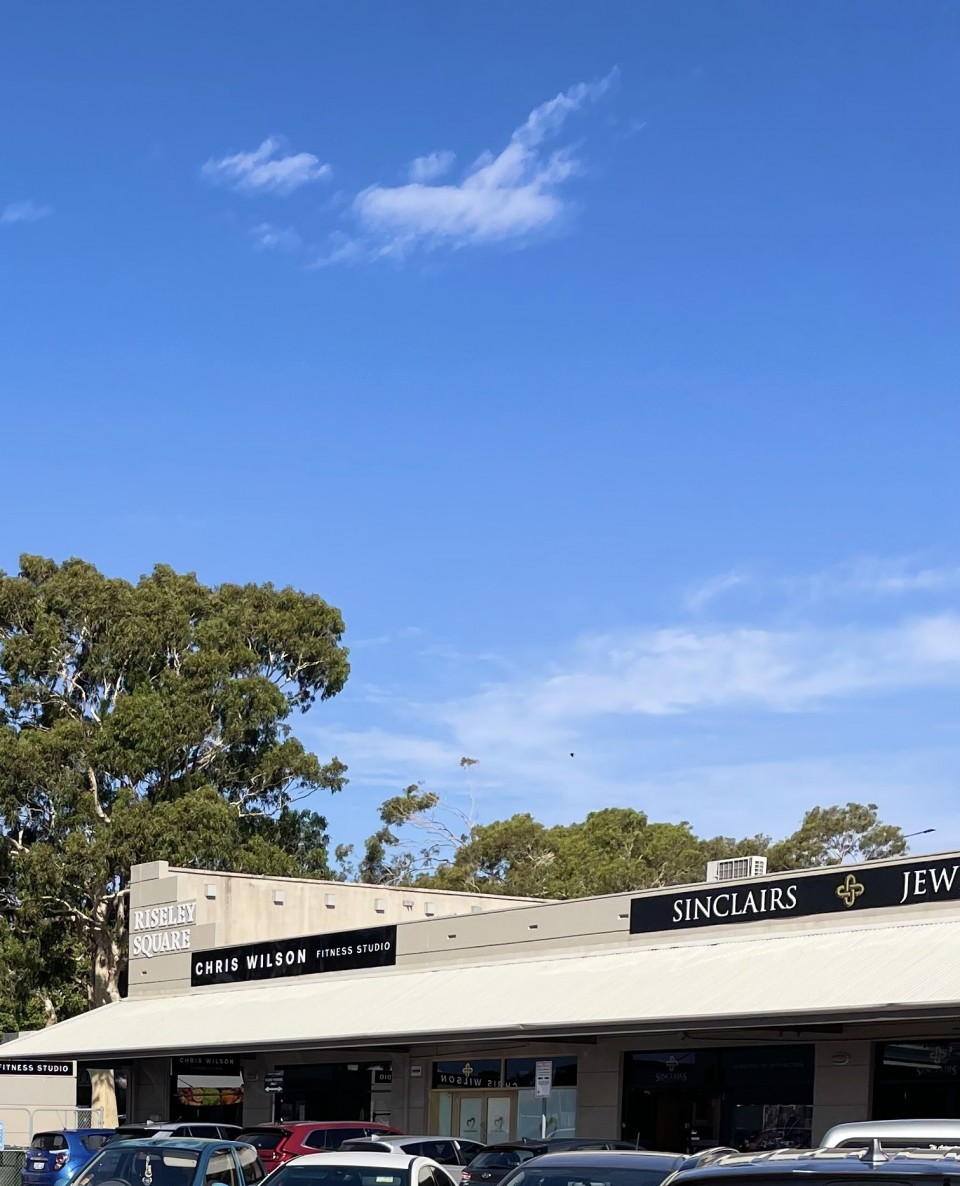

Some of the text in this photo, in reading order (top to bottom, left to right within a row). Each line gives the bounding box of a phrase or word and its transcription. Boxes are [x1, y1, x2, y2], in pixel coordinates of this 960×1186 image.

[672, 865, 960, 923] SINCLAIRS JEW
[134, 902, 196, 931] RISELEY
[133, 929, 190, 959] SQUARE
[195, 941, 391, 976] CHRIS WILSON FITNESS STUDIO
[37, 1064, 69, 1073] STUDIO
[179, 1057, 203, 1065] CHRIS
